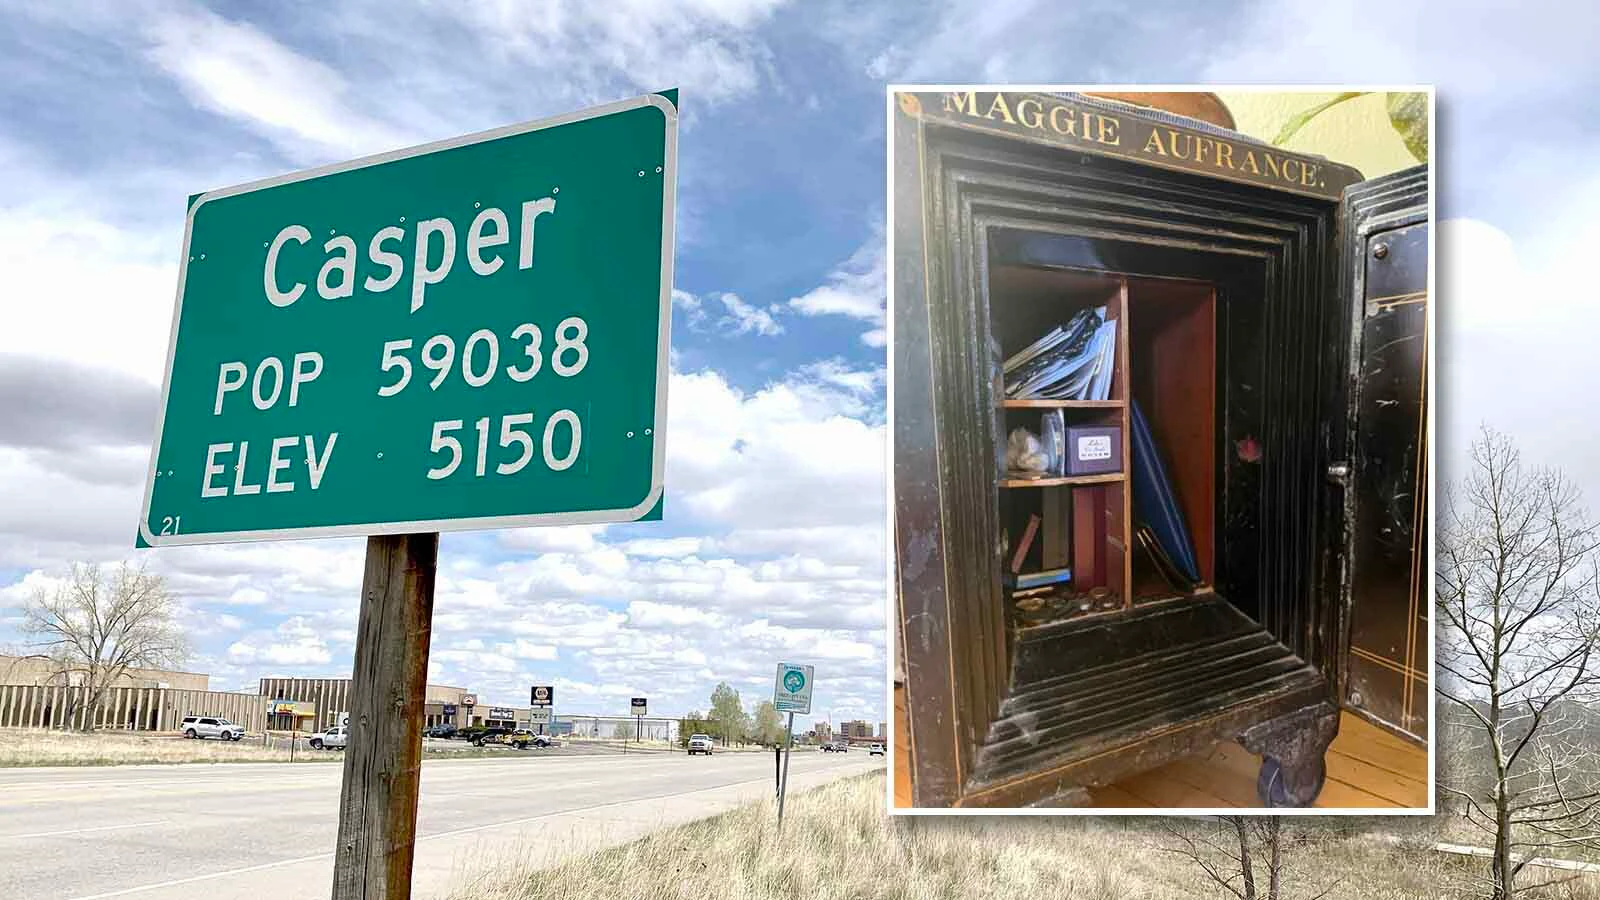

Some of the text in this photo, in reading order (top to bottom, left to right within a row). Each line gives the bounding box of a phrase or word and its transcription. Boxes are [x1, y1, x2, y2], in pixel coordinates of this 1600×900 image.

[942, 92, 1327, 189] MAGGIE AUFRANCE.
[264, 196, 557, 314] Casper
[213, 316, 589, 416] POP 59038
[200, 408, 582, 498] ELEV 5150
[160, 516, 180, 536] 21
